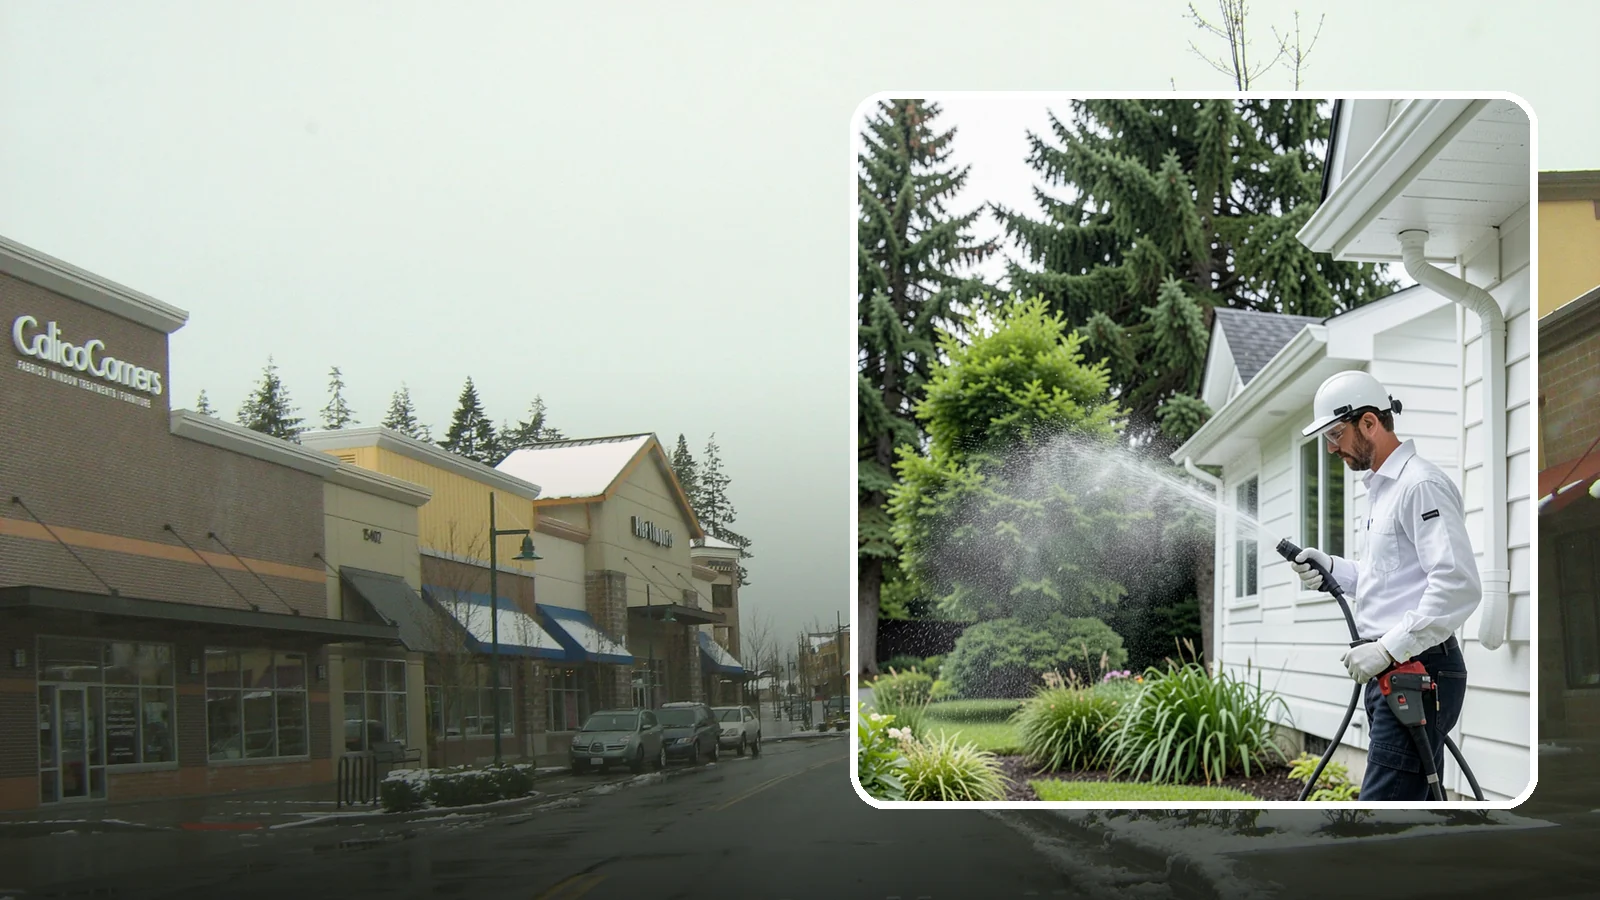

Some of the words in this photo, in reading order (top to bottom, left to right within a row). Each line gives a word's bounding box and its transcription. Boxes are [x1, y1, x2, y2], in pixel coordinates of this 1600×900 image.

[12, 315, 162, 396] CalicoCorners
[17, 360, 47, 378] FABRICS
[51, 370, 78, 387] WINDOW
[79, 379, 116, 399] TREATMENTS
[120, 391, 151, 409] FURNITURE
